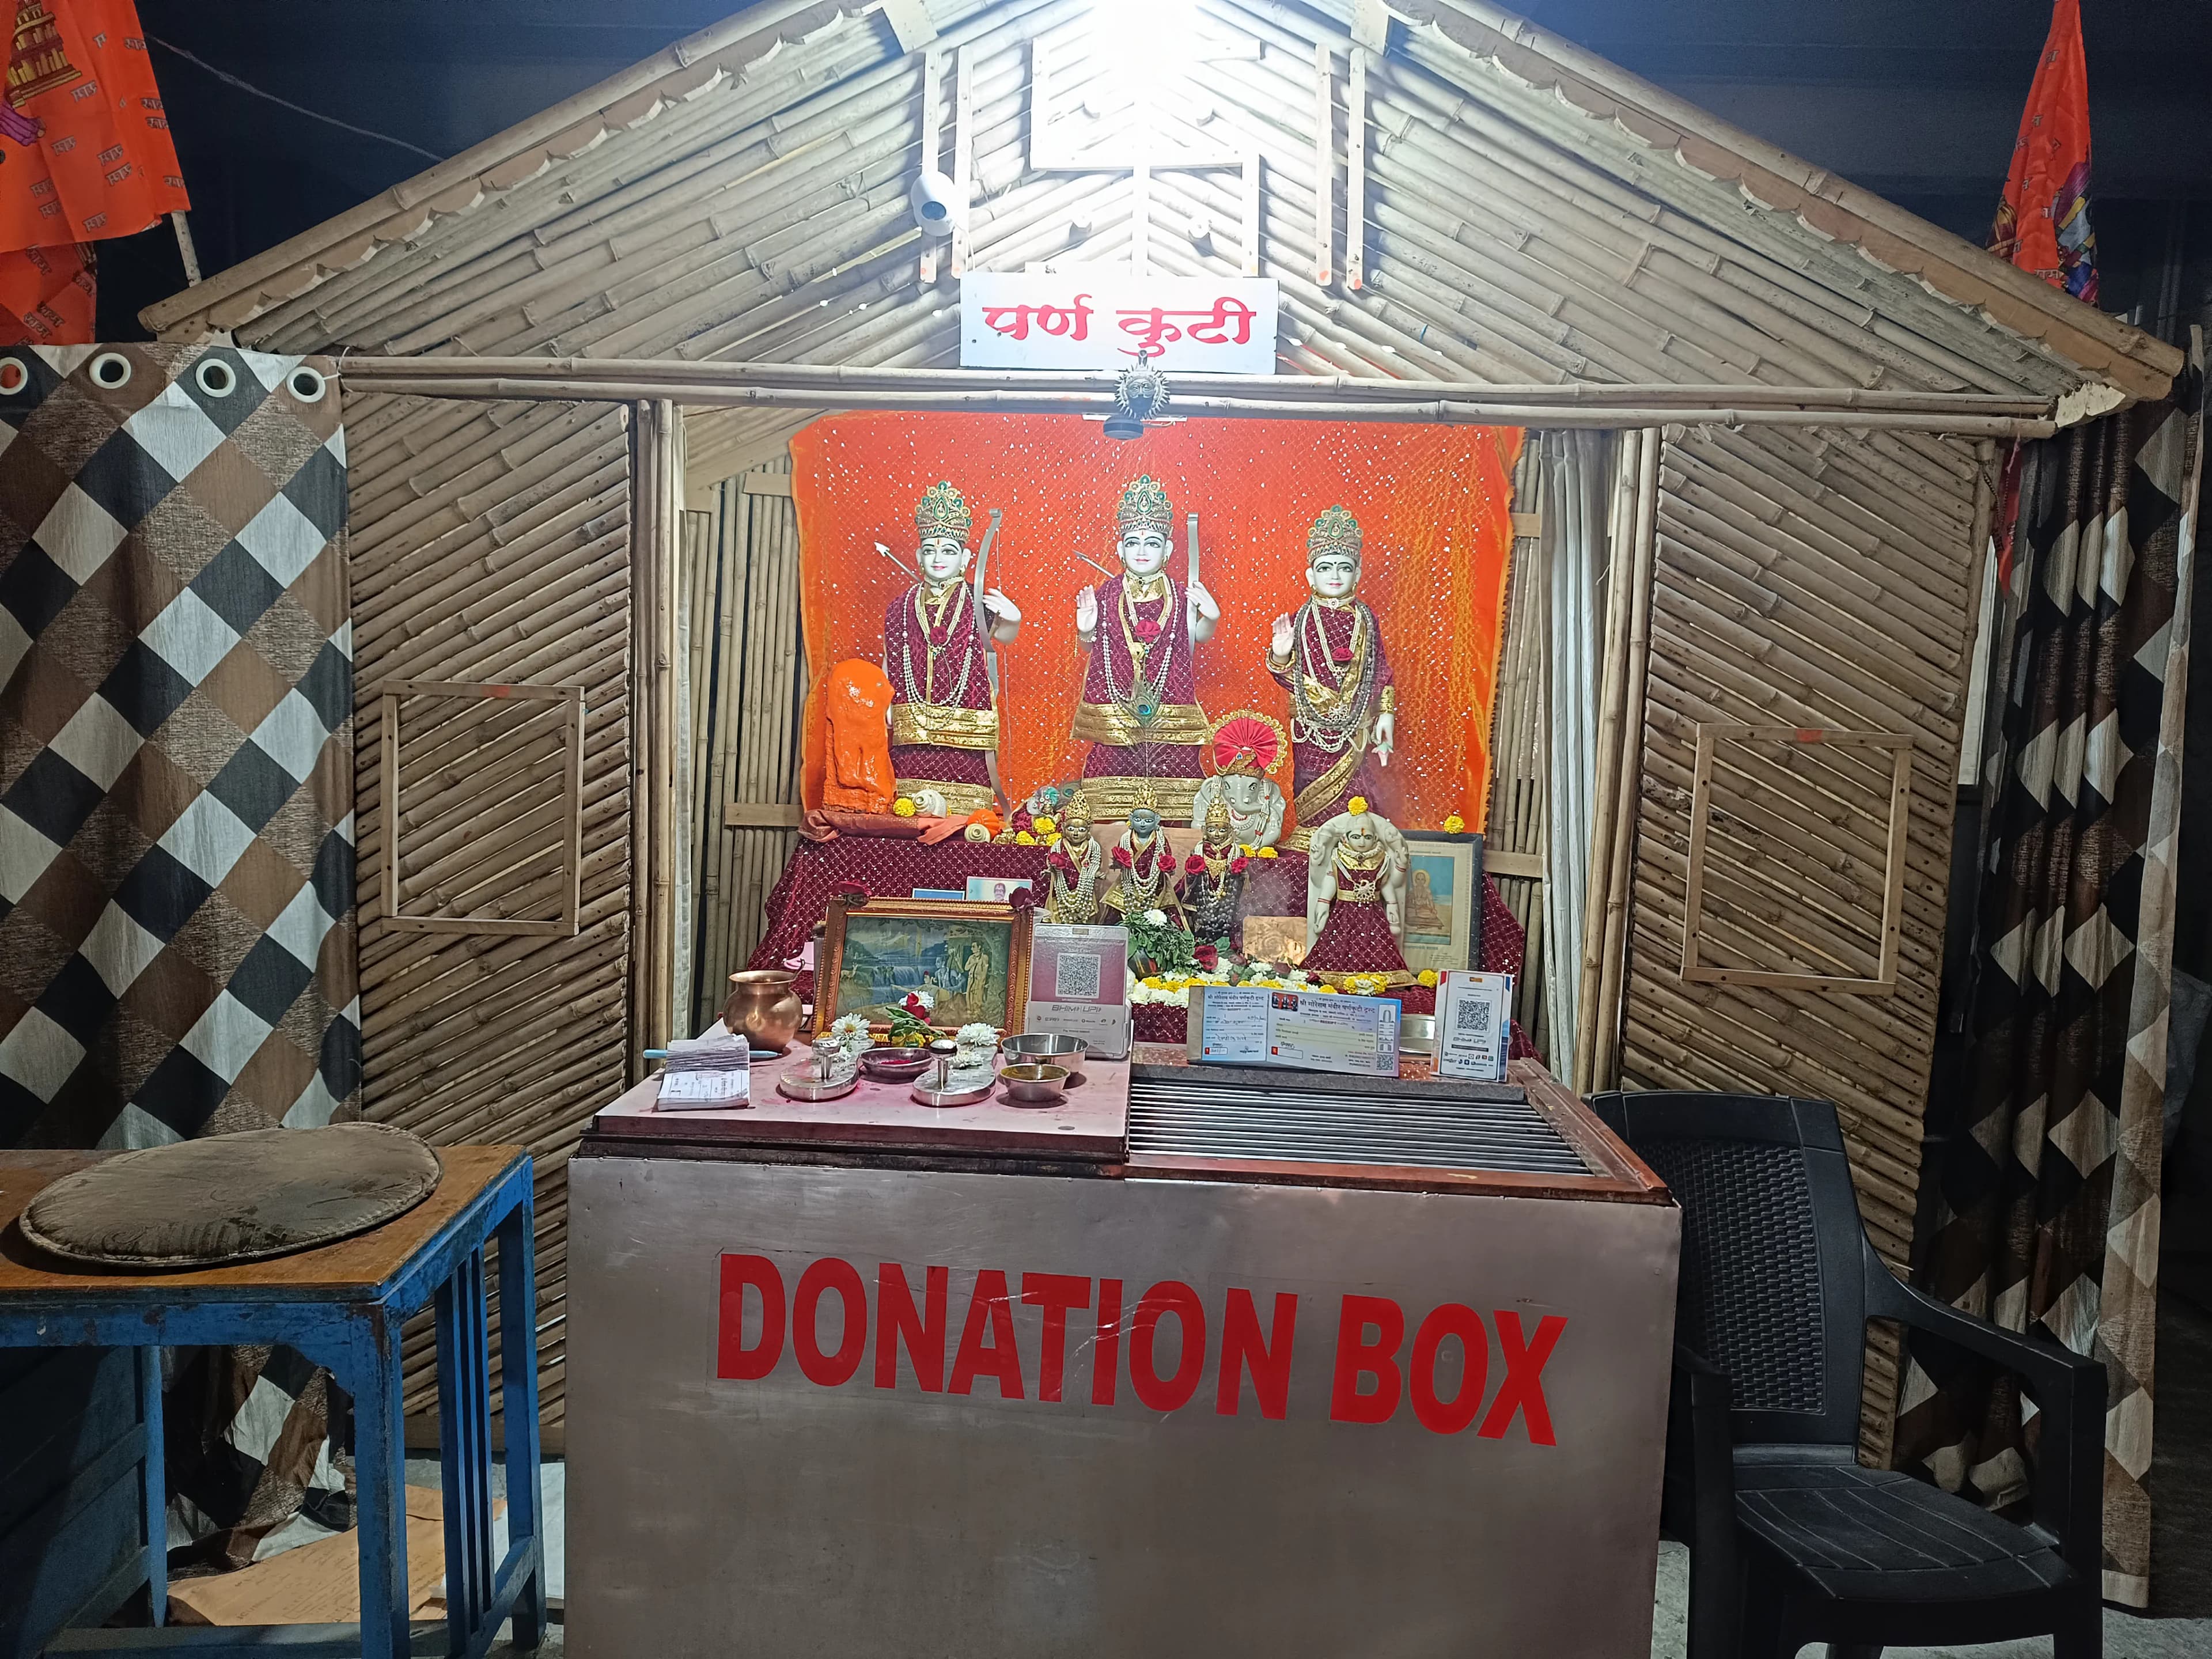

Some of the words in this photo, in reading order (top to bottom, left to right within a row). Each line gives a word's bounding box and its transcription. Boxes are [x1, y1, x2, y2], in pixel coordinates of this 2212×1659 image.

[982, 294, 1093, 341] पर्ण
[1116, 297, 1256, 358] कुटी
[717, 1253, 1298, 1420] DONATION
[1330, 1294, 1568, 1446] BOX
